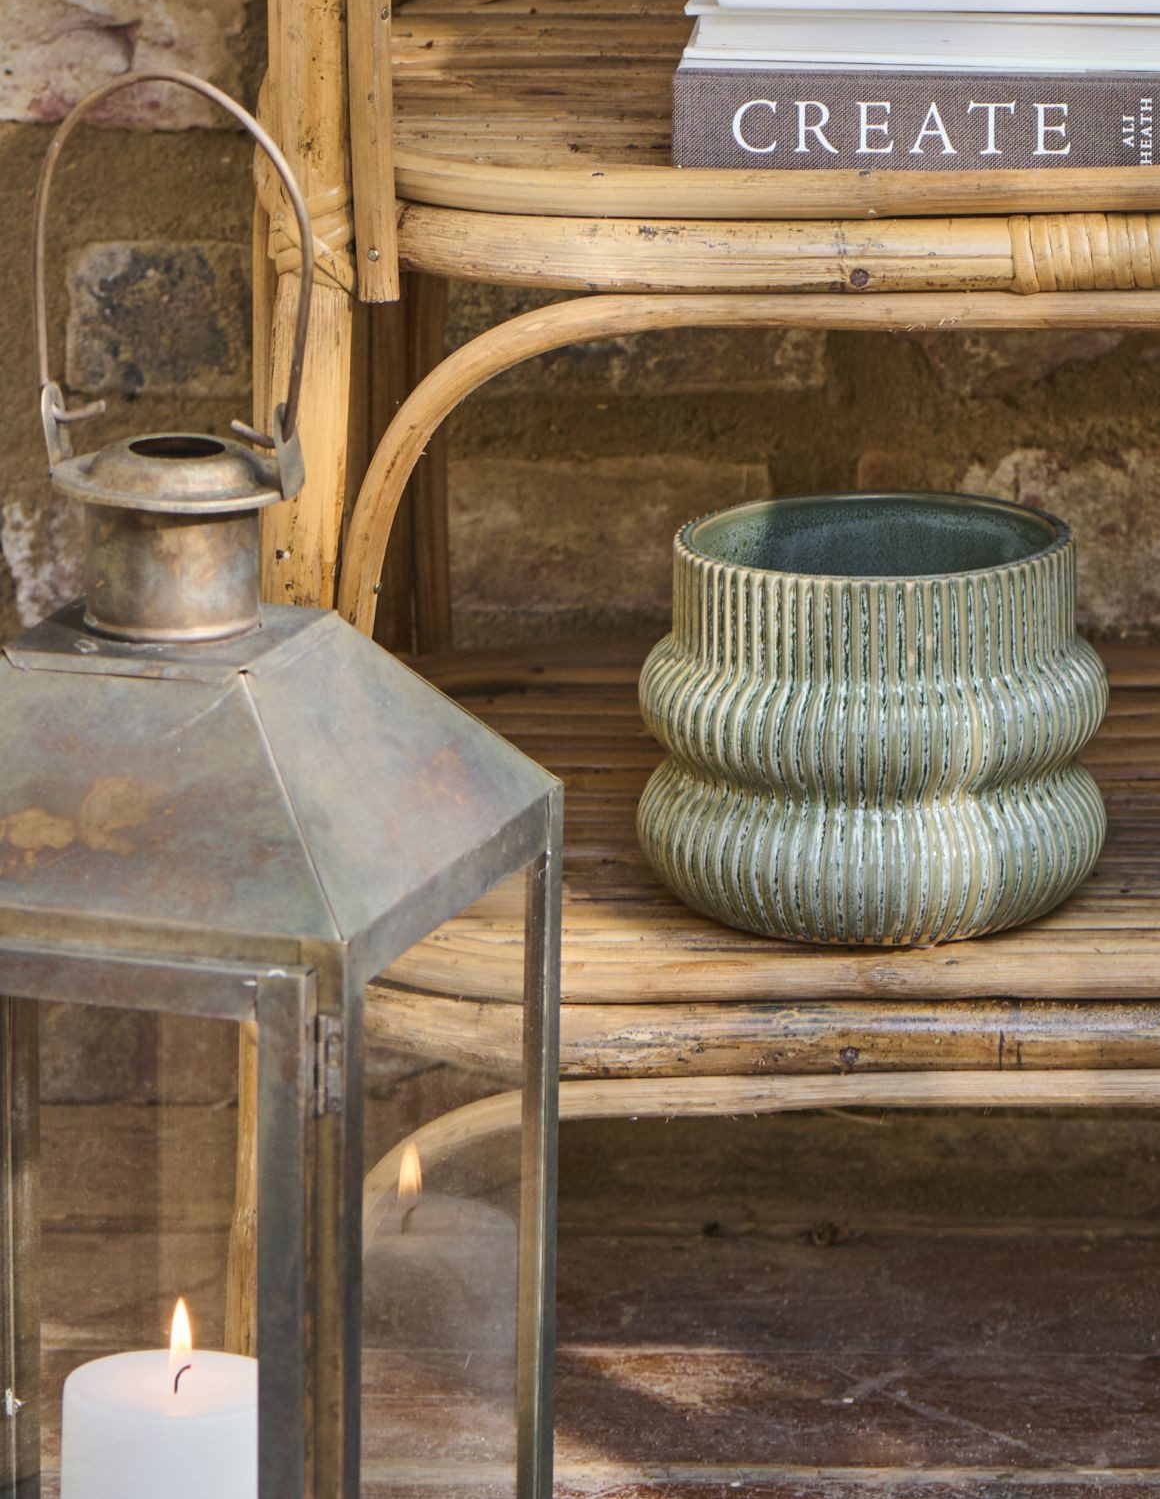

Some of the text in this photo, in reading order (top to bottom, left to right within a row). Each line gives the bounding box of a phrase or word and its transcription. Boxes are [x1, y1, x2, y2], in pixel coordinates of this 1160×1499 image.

[732, 99, 1071, 156] CREATE
[1122, 114, 1135, 148] ALI
[1139, 97, 1153, 165] HEATH
